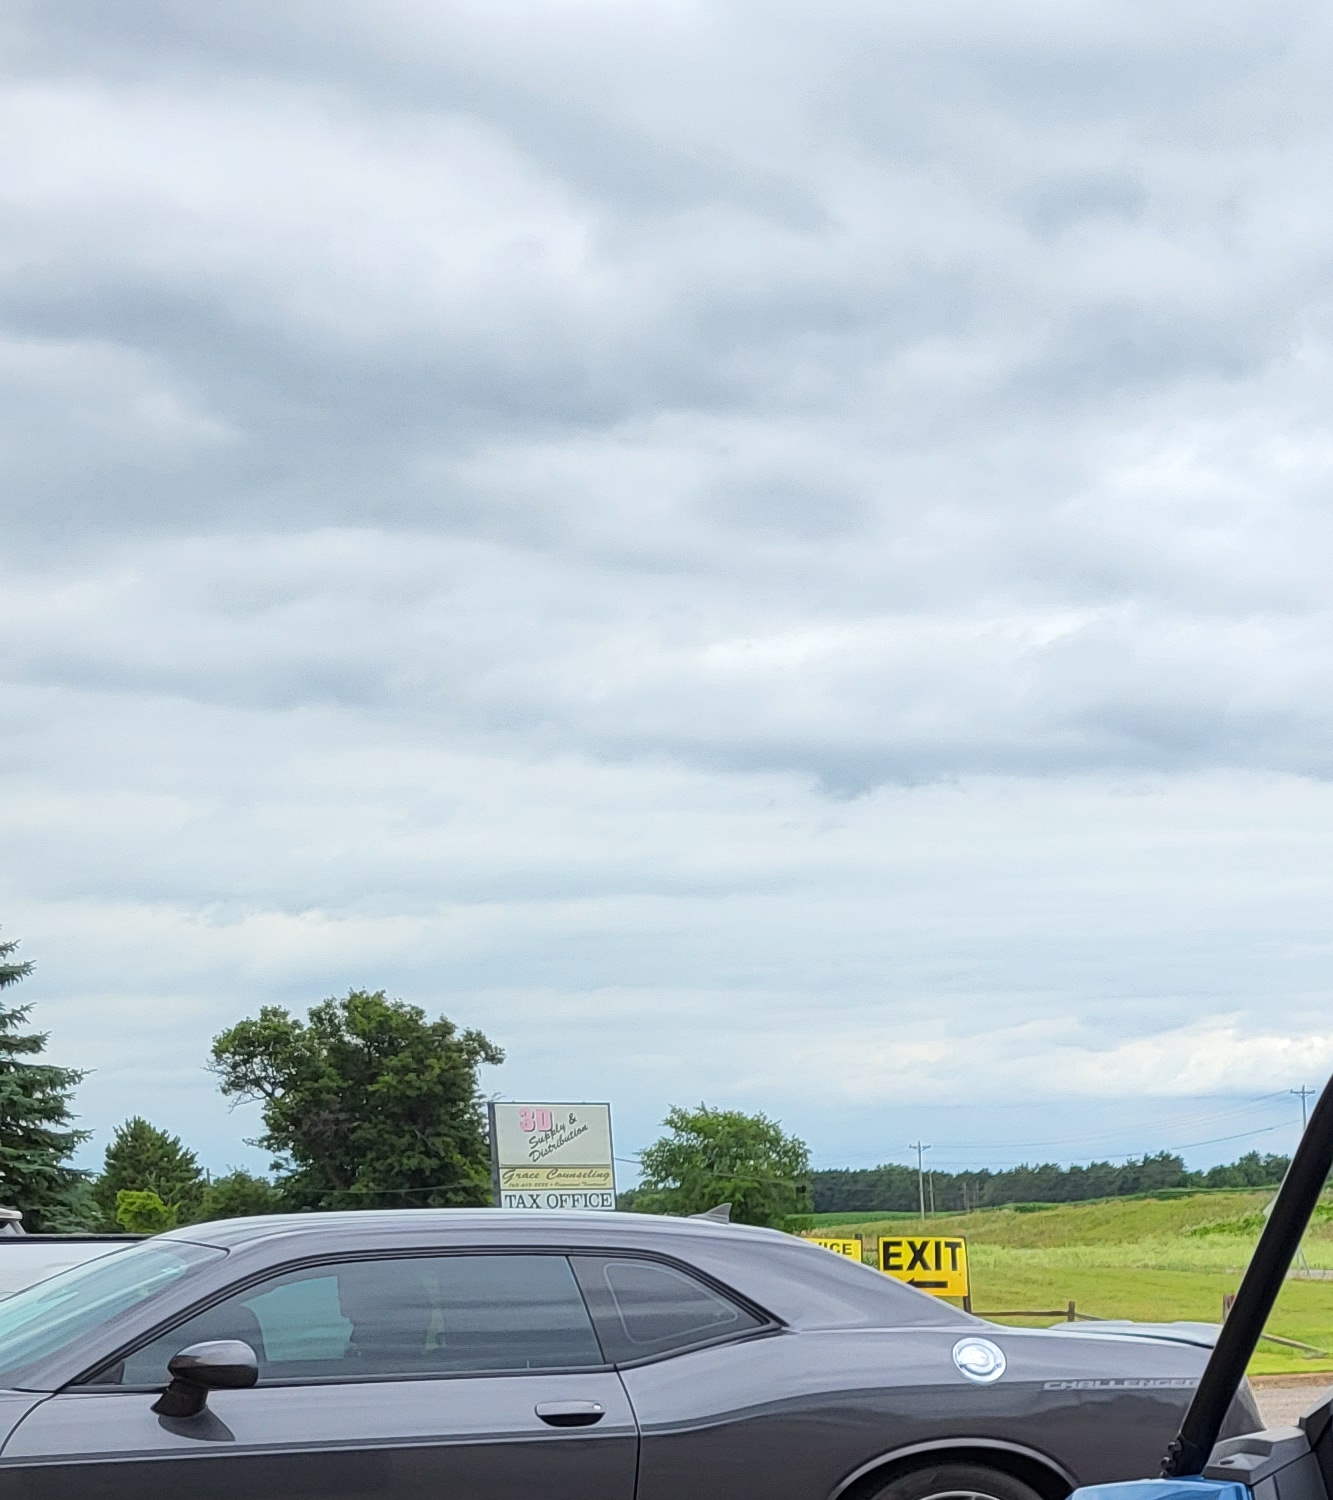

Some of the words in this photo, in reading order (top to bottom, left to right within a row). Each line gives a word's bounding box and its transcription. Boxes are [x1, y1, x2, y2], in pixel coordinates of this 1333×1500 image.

[519, 1107, 553, 1132] 3D
[528, 1122, 566, 1150] Supply
[568, 1112, 577, 1125] &
[528, 1124, 588, 1163] Distribution
[502, 1168, 540, 1185] Grace
[545, 1168, 610, 1182] Counseling
[505, 1194, 541, 1208] TAX
[546, 1193, 612, 1209] OFFICE
[883, 1240, 962, 1271] EXIT
